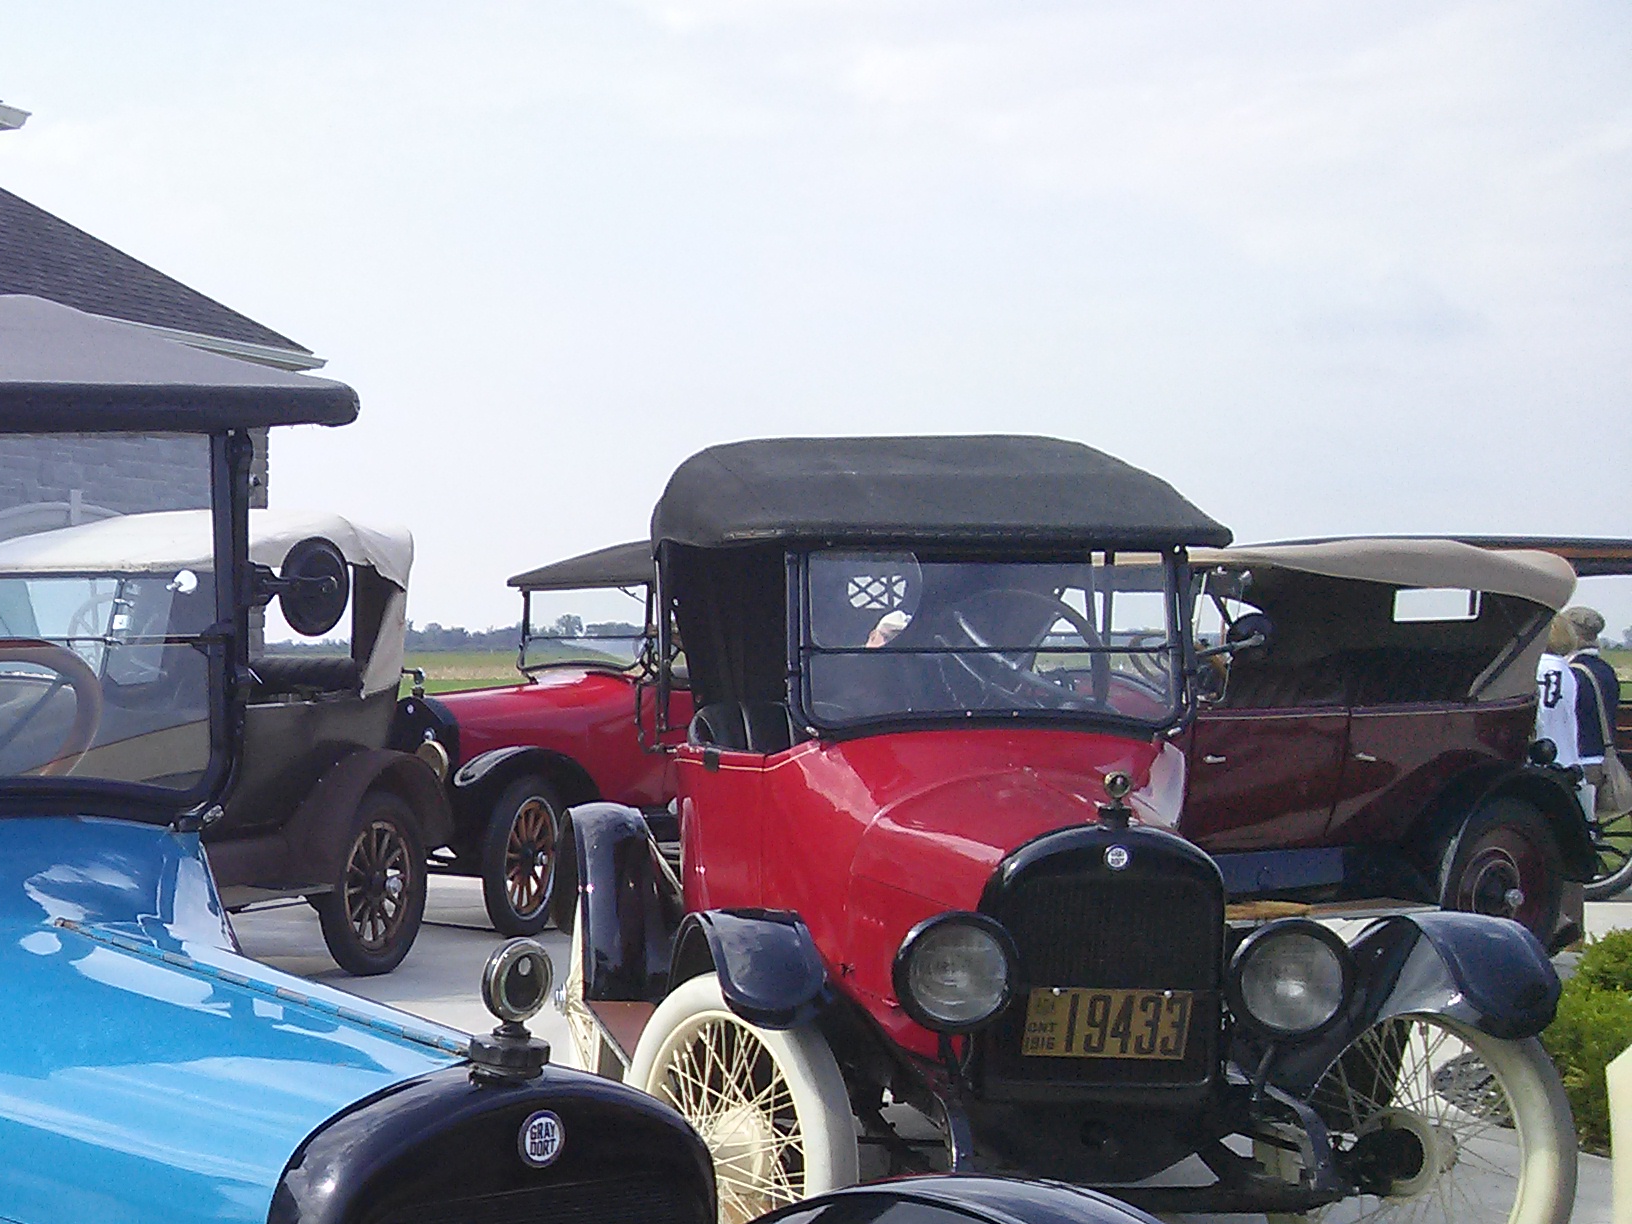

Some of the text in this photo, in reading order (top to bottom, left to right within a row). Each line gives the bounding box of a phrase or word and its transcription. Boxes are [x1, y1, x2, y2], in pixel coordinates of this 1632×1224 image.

[1064, 992, 1189, 1055] 19433
[529, 1122, 556, 1139] GRAY
[529, 1139, 557, 1156] DORT
